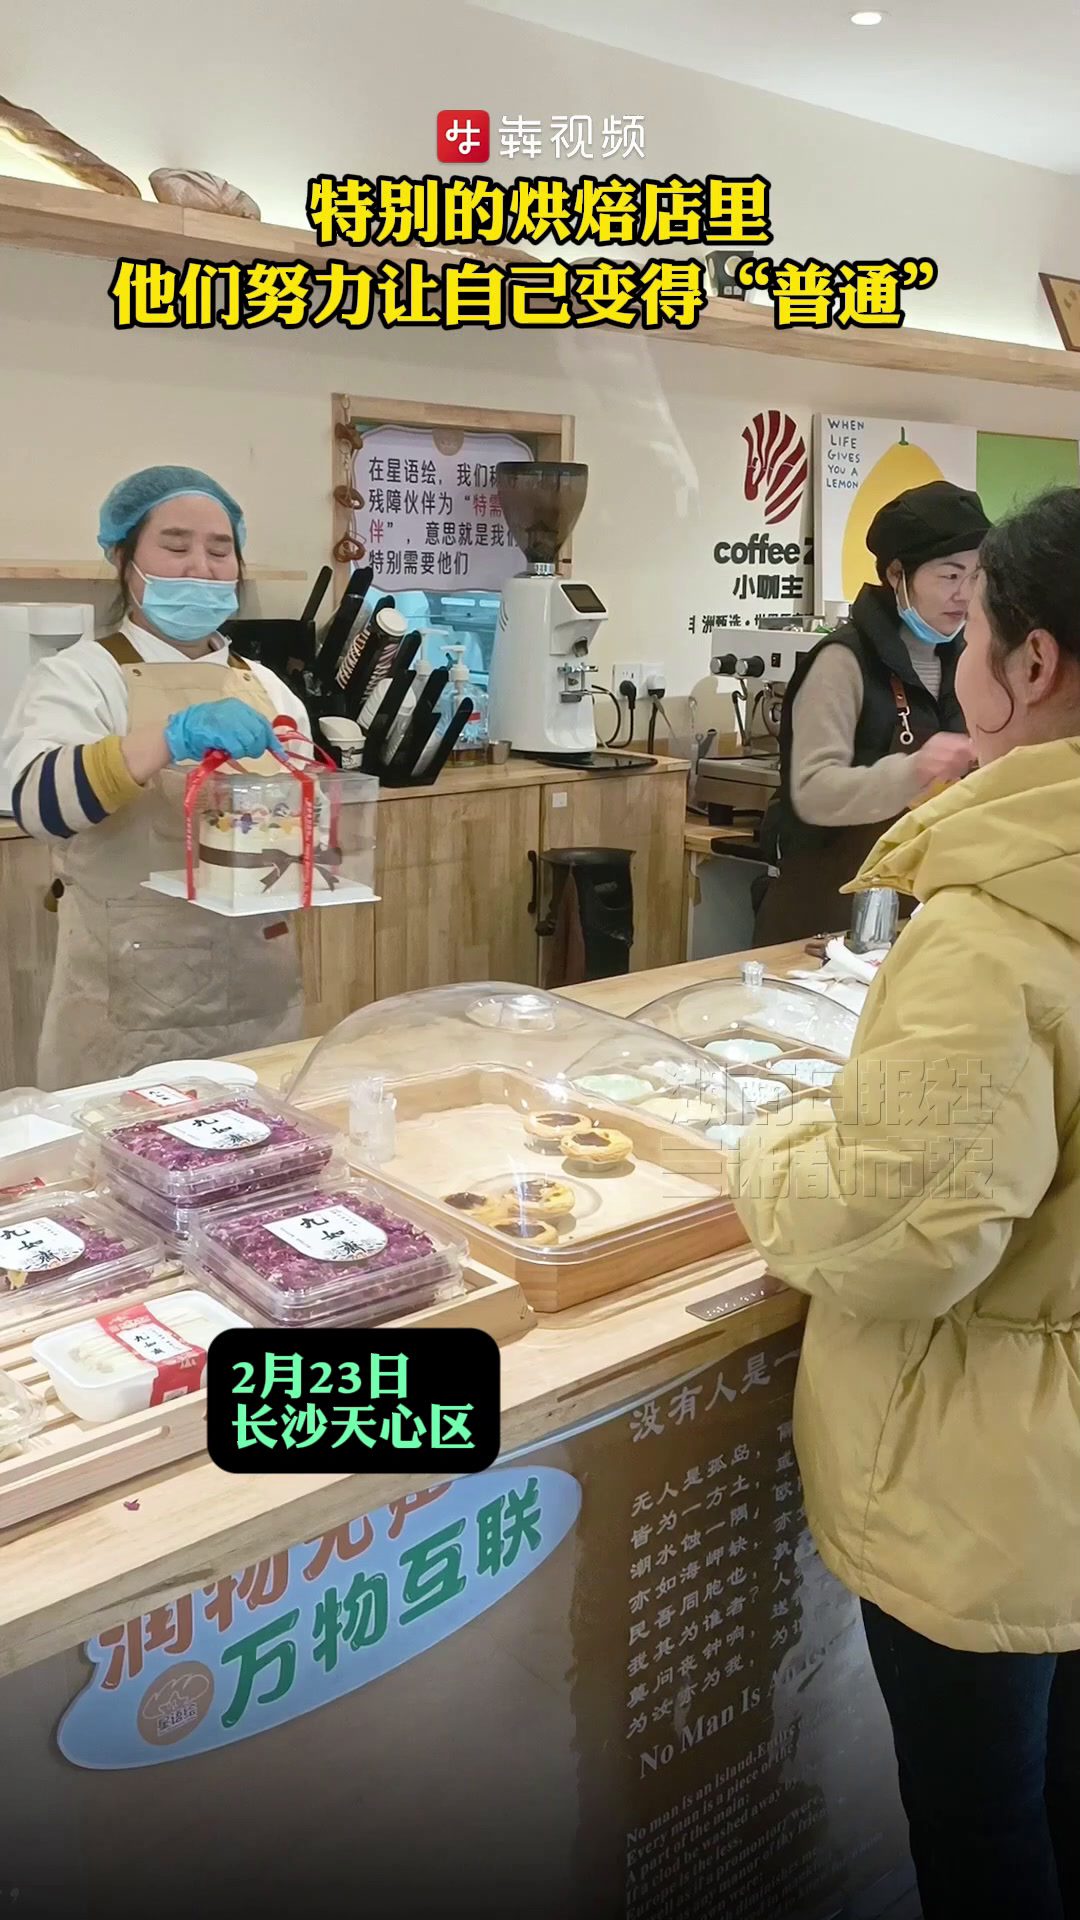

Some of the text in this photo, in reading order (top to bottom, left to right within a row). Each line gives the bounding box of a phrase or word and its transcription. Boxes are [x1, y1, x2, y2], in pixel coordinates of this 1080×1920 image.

[827, 417, 865, 431] WHEN
[827, 449, 861, 463] GIVES
[830, 434, 857, 449] LIFE
[826, 477, 859, 489] LEMON
[828, 464, 859, 477] YOU A
[369, 550, 469, 575] 特别需要他们
[713, 533, 800, 564] coffee
[220, 1477, 542, 1728] 万物互联
[639, 1744, 675, 1780] No
[680, 1704, 734, 1755] Man
[740, 1685, 761, 1716] Is
[626, 1827, 647, 1848] No
[649, 1805, 679, 1833] man
[695, 1782, 713, 1801] an
[626, 1830, 668, 1868] Every
[671, 1809, 700, 1837] man
[727, 1769, 759, 1803] piece
[702, 1808, 748, 1851] washed
[625, 1869, 636, 1888] A
[640, 1846, 670, 1881] part
[690, 1820, 711, 1843] the
